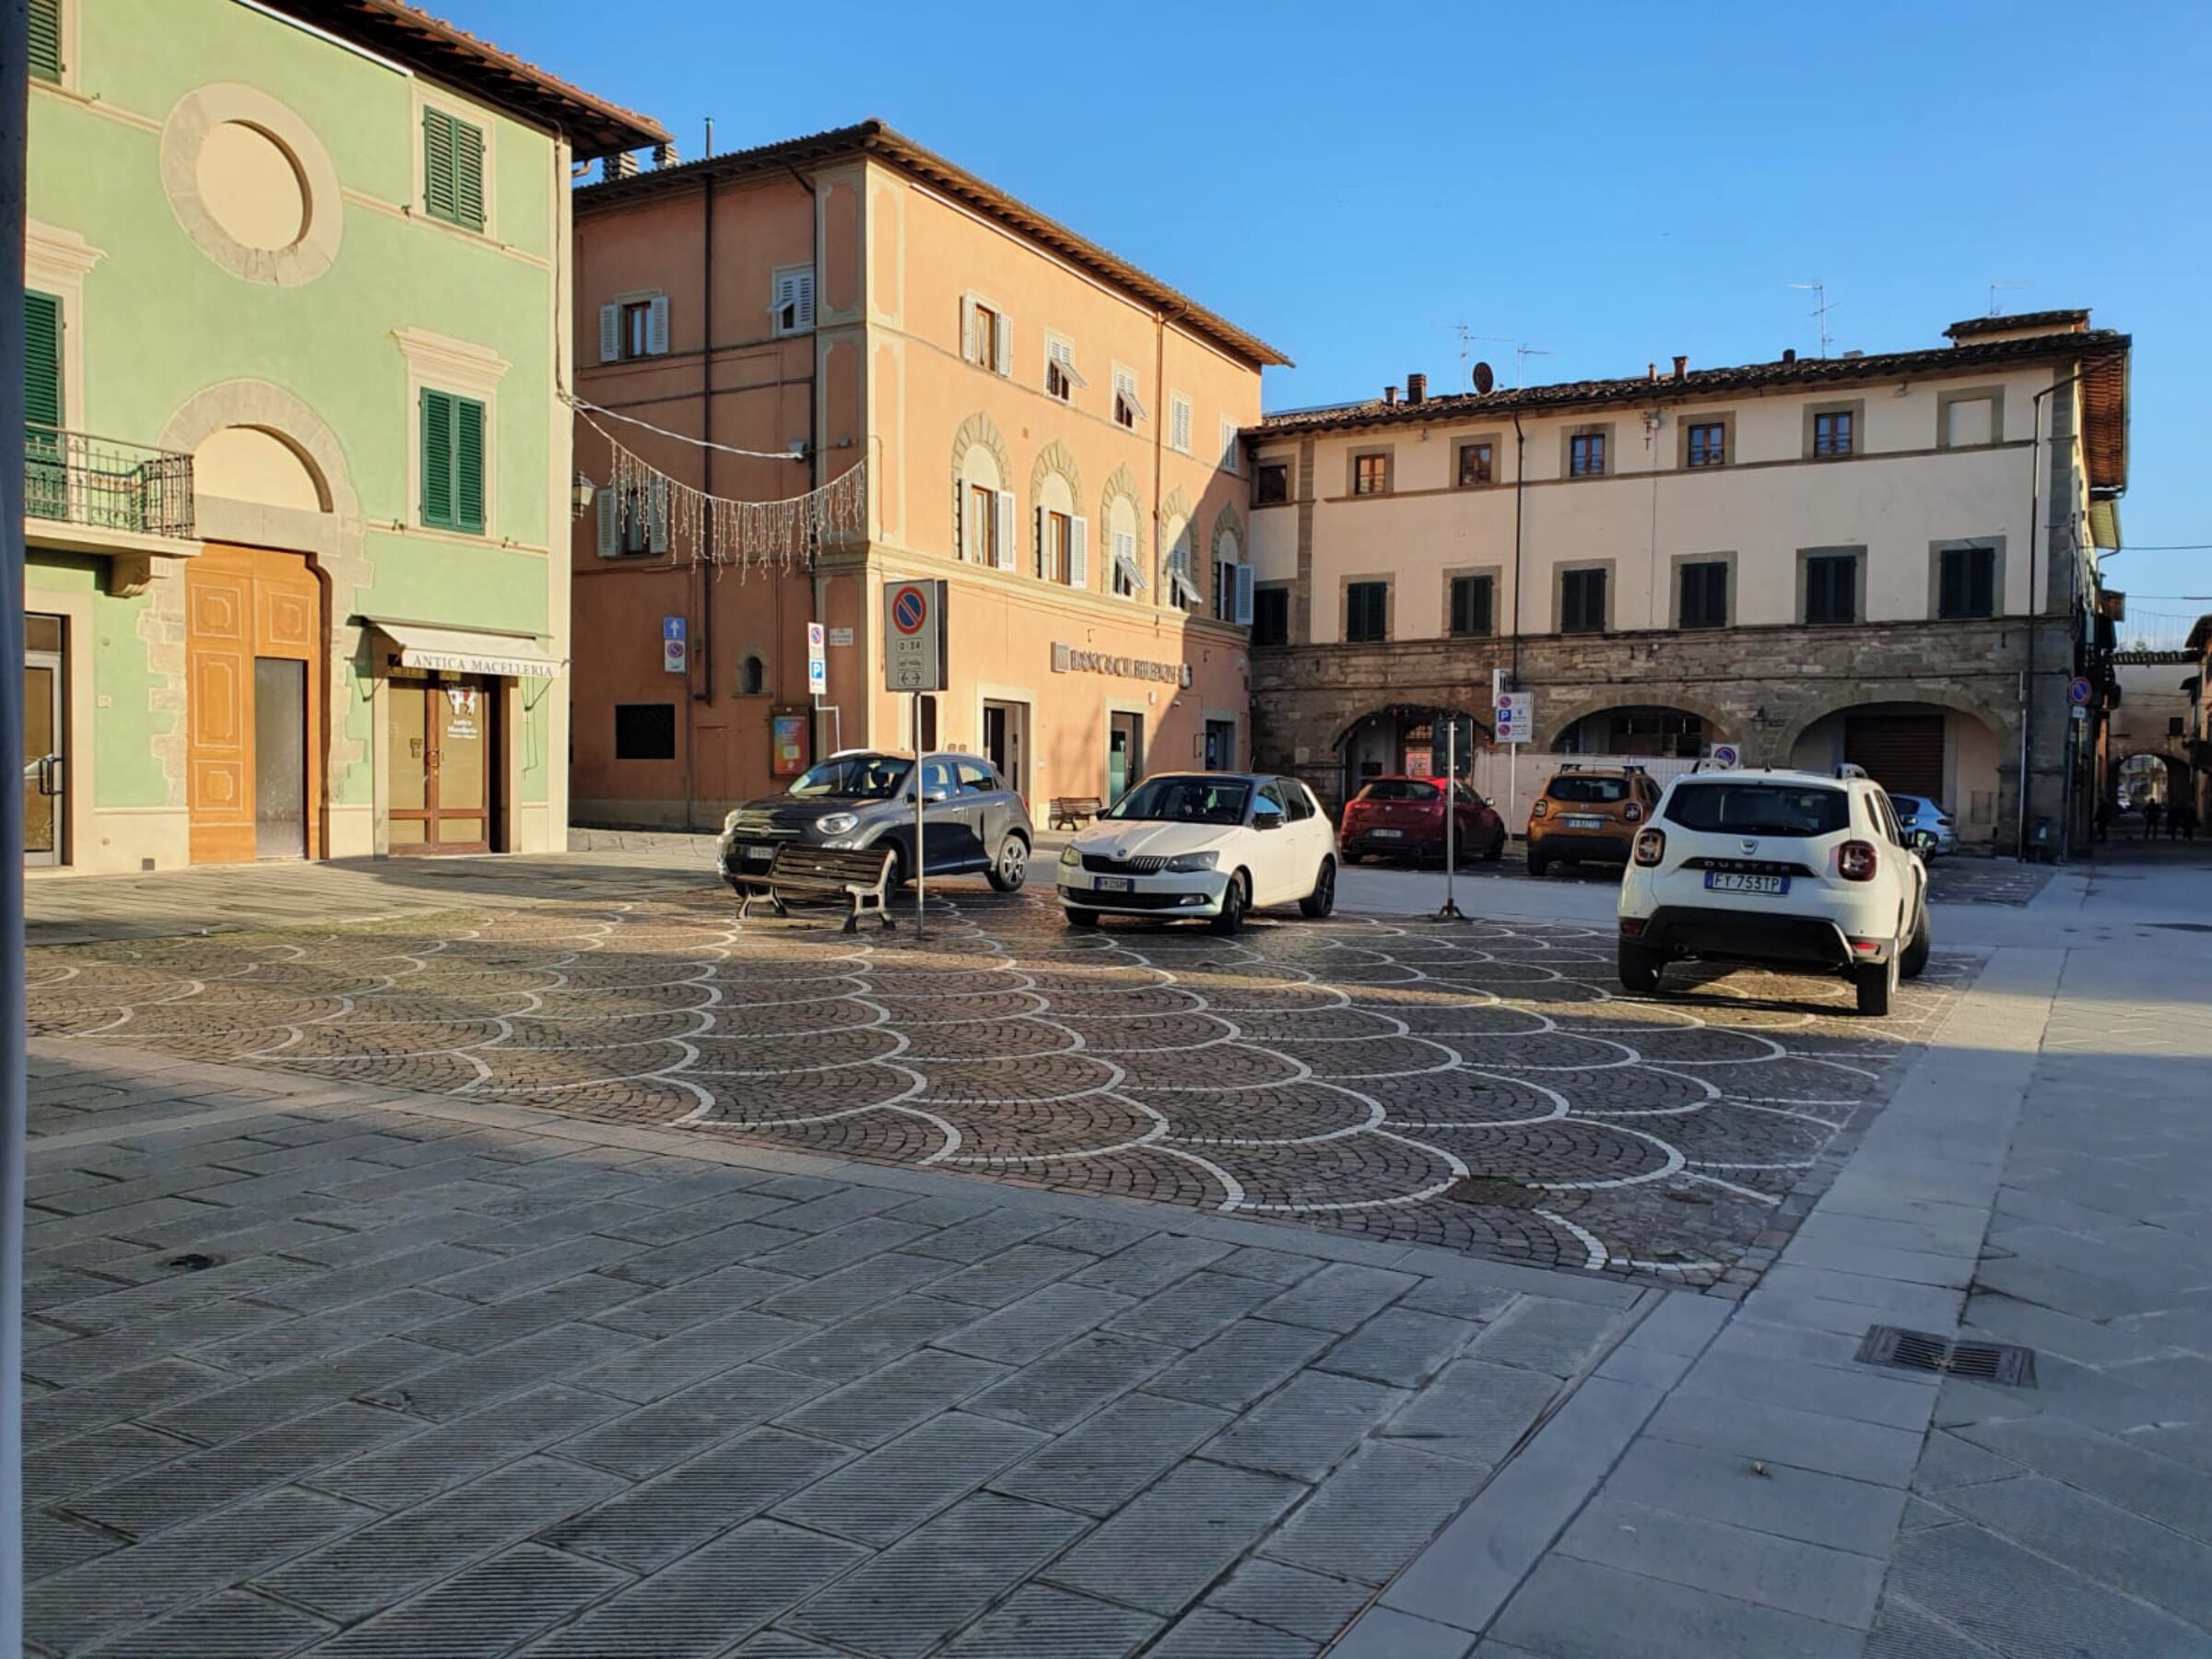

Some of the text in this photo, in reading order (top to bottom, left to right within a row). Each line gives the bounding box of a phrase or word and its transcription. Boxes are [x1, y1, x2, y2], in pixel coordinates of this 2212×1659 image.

[414, 654, 465, 670] ANTICA
[471, 659, 553, 677] MACELLERIA
[1714, 874, 1780, 891] FY 753TP
